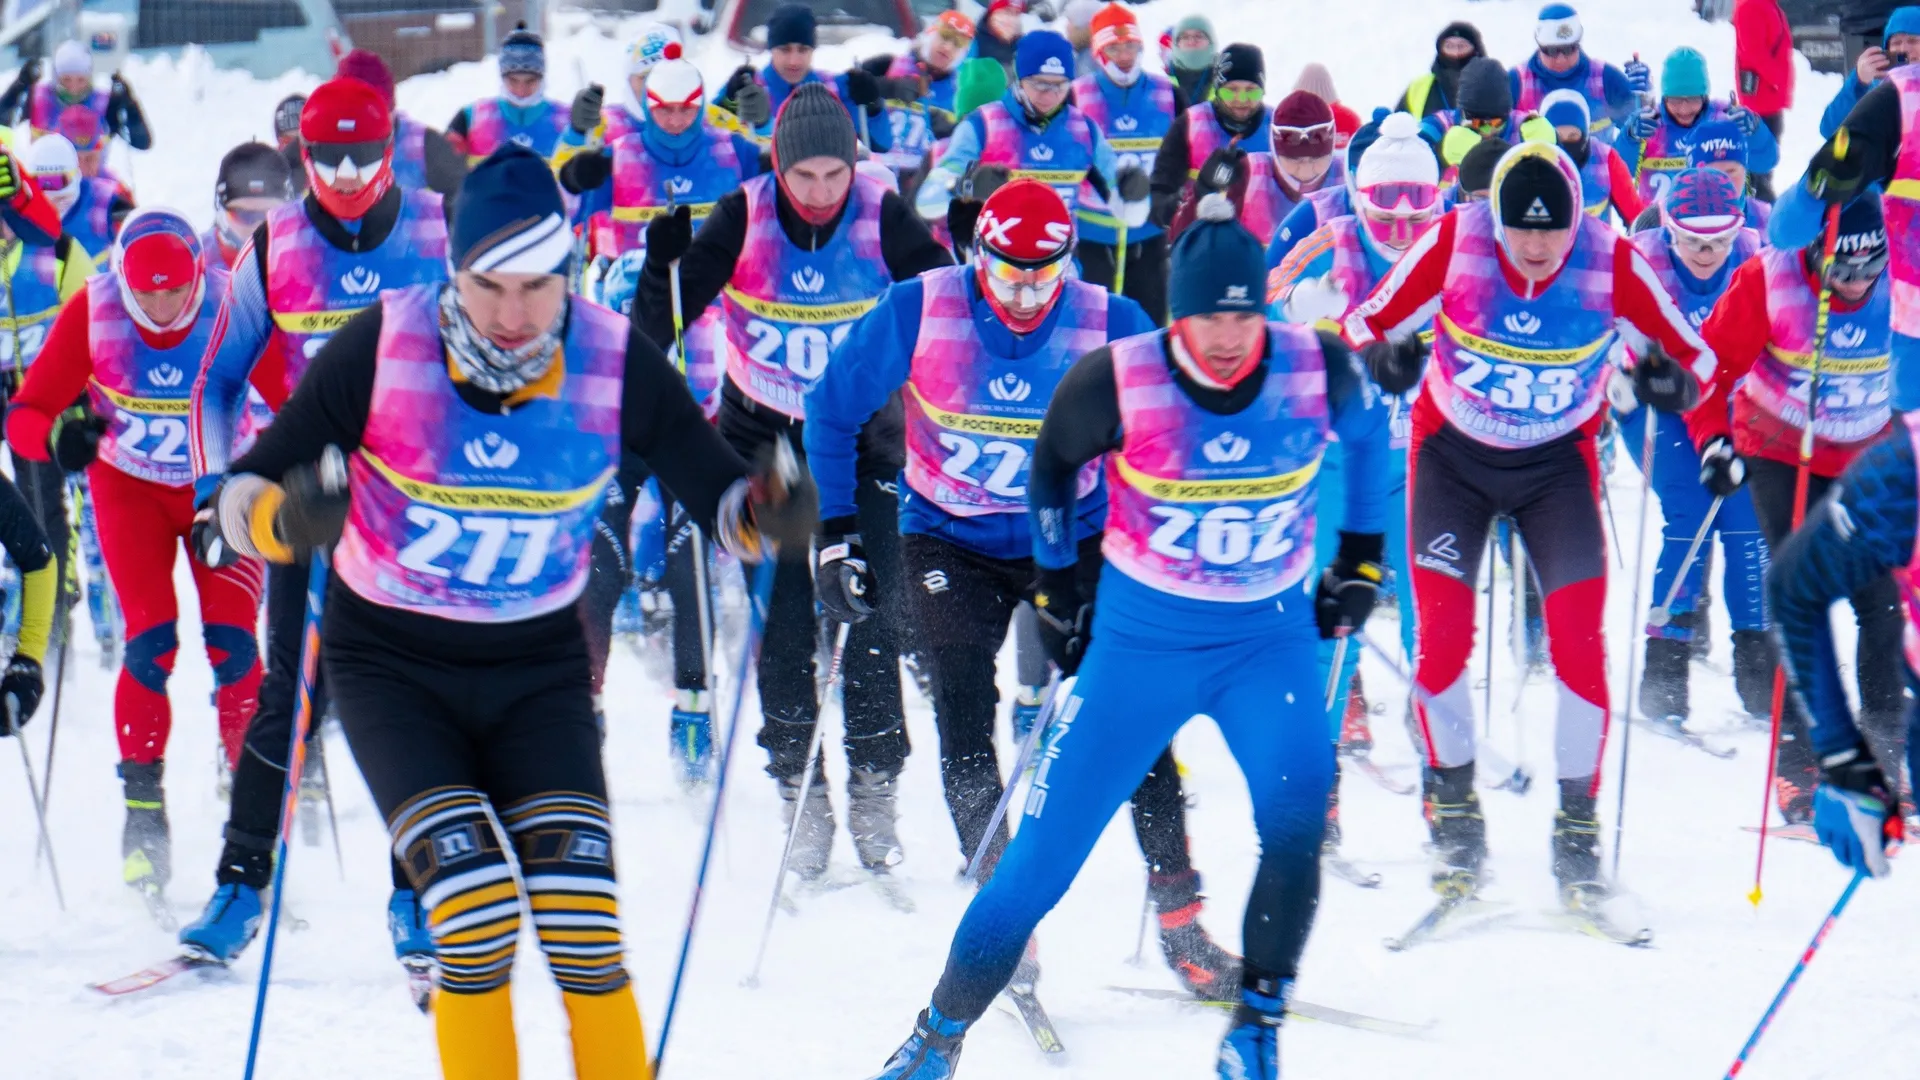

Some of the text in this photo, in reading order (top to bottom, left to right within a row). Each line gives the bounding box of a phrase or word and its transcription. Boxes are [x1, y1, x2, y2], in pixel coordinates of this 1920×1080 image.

[1453, 349, 1578, 415] 233
[115, 408, 187, 463] 22
[939, 432, 1028, 497] 22
[396, 505, 557, 586] 277
[1148, 499, 1299, 566] 262
